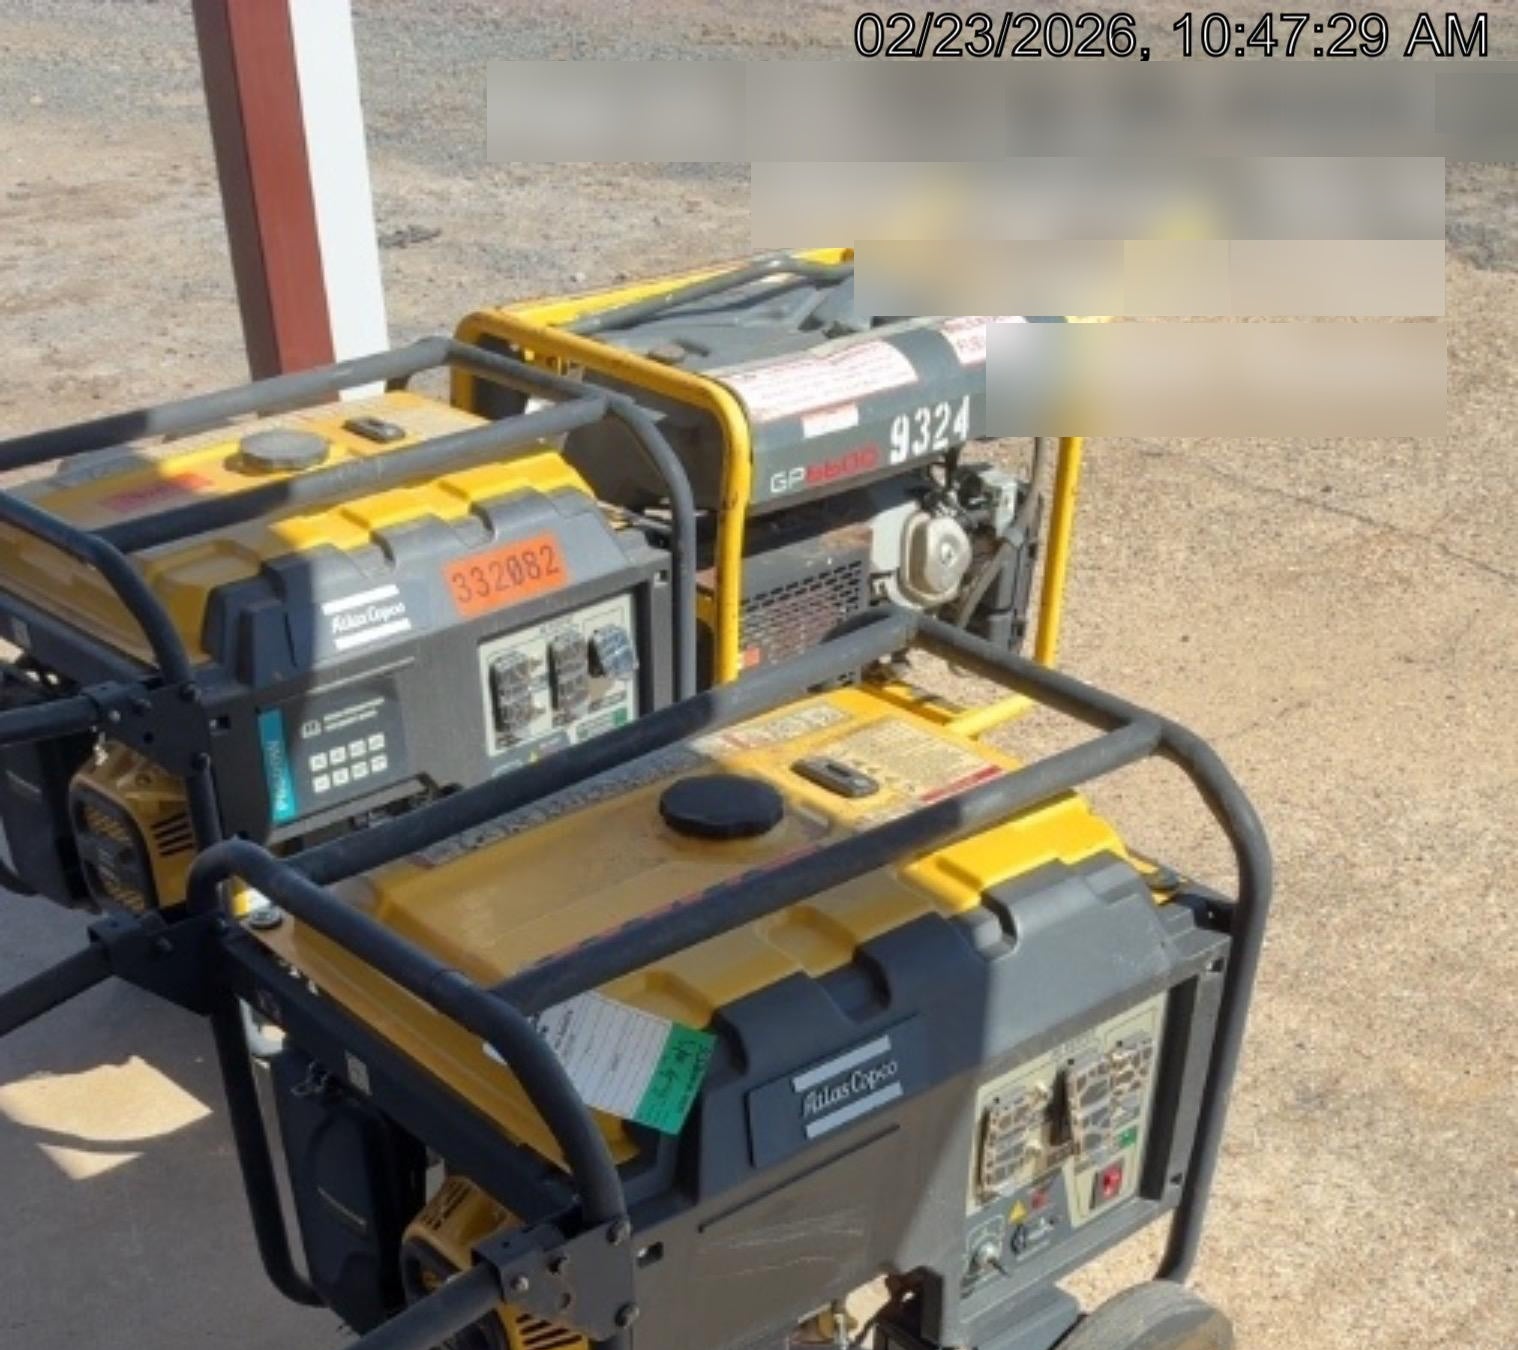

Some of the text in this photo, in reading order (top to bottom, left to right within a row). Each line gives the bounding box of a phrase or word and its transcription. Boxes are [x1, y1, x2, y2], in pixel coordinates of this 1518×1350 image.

[889, 394, 971, 465] 9324
[452, 544, 560, 604] 332082
[803, 1060, 898, 1118] Atlas Copco
